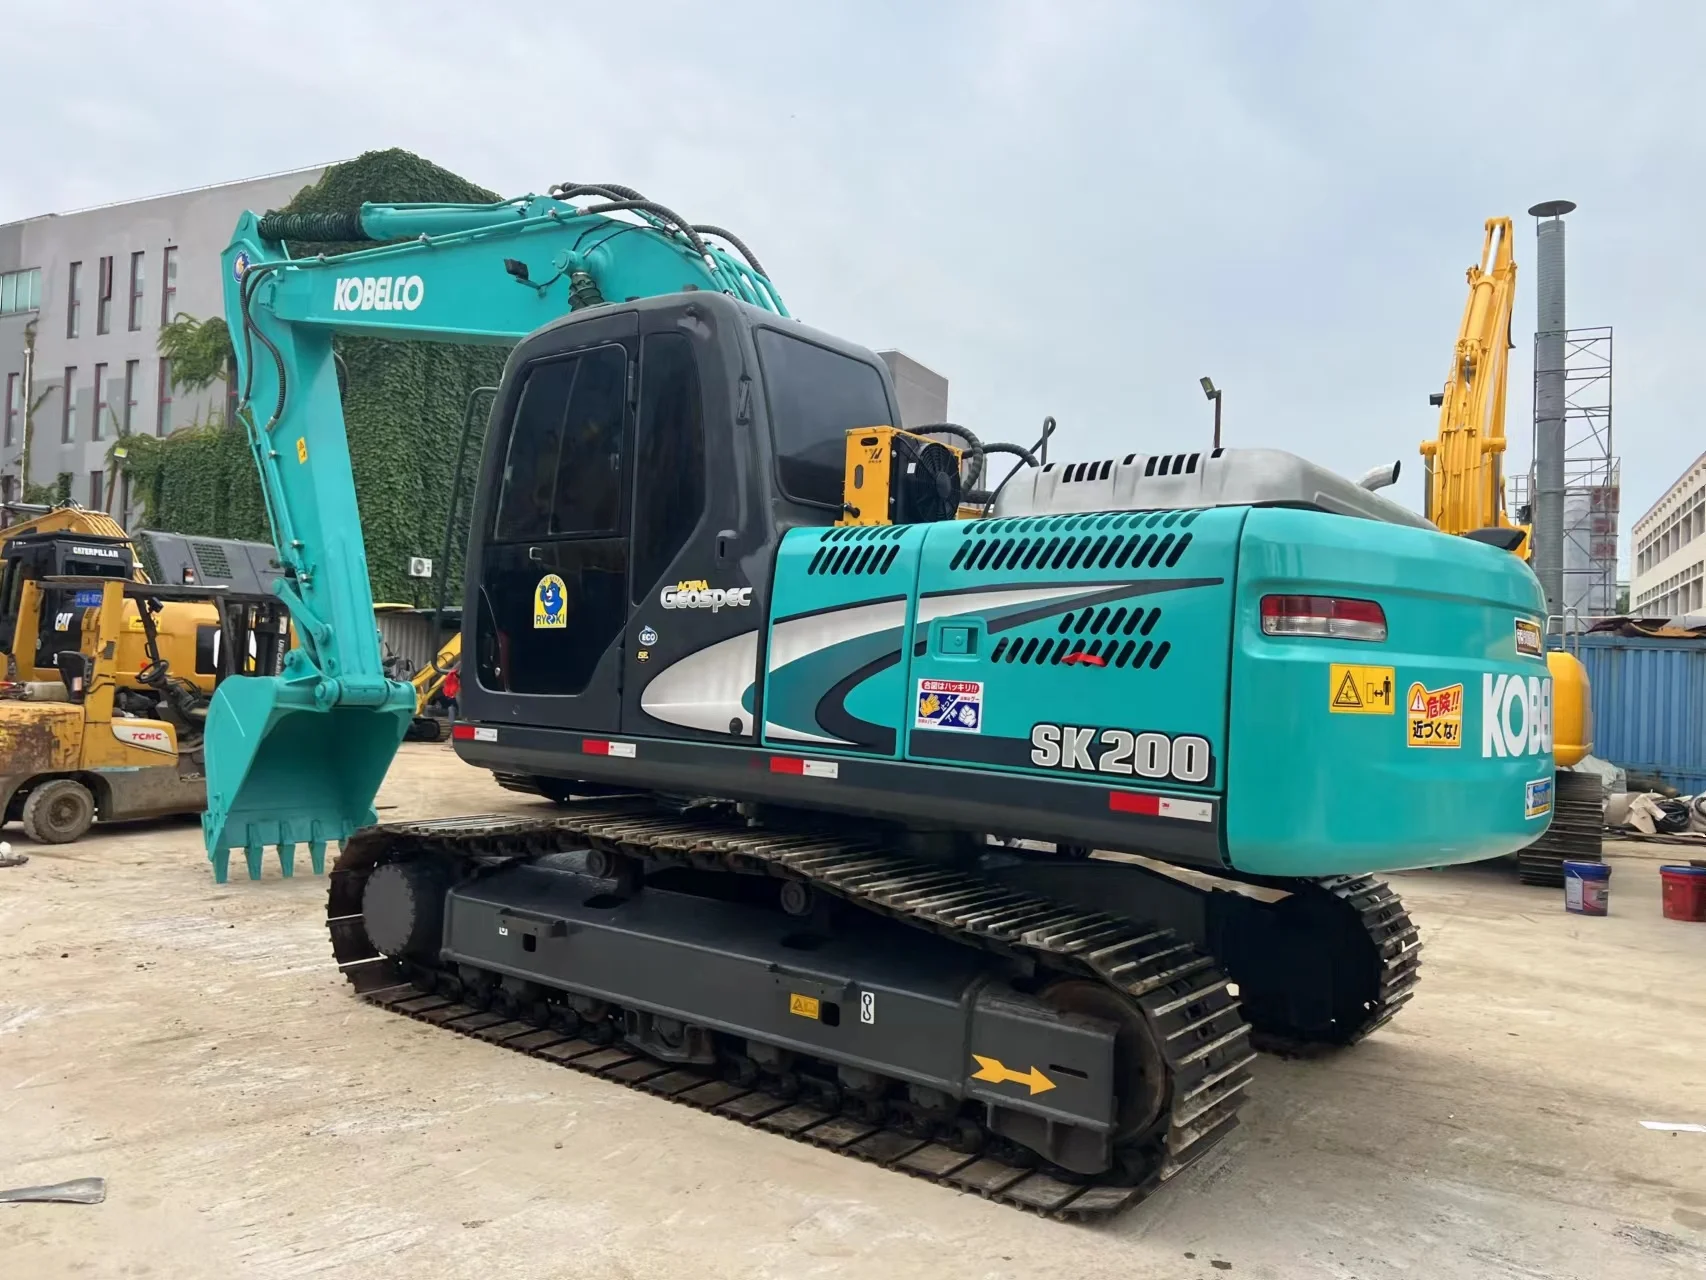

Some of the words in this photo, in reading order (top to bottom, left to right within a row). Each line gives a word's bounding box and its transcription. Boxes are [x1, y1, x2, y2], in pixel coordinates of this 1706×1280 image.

[333, 275, 424, 311] KOBELCO
[72, 546, 119, 558] CATERPILLAR
[54, 612, 73, 631] CAT
[641, 633, 656, 641] ECO
[1482, 672, 1554, 758] KOBE
[131, 732, 162, 741] TCMC
[1031, 724, 1210, 783] SK200
